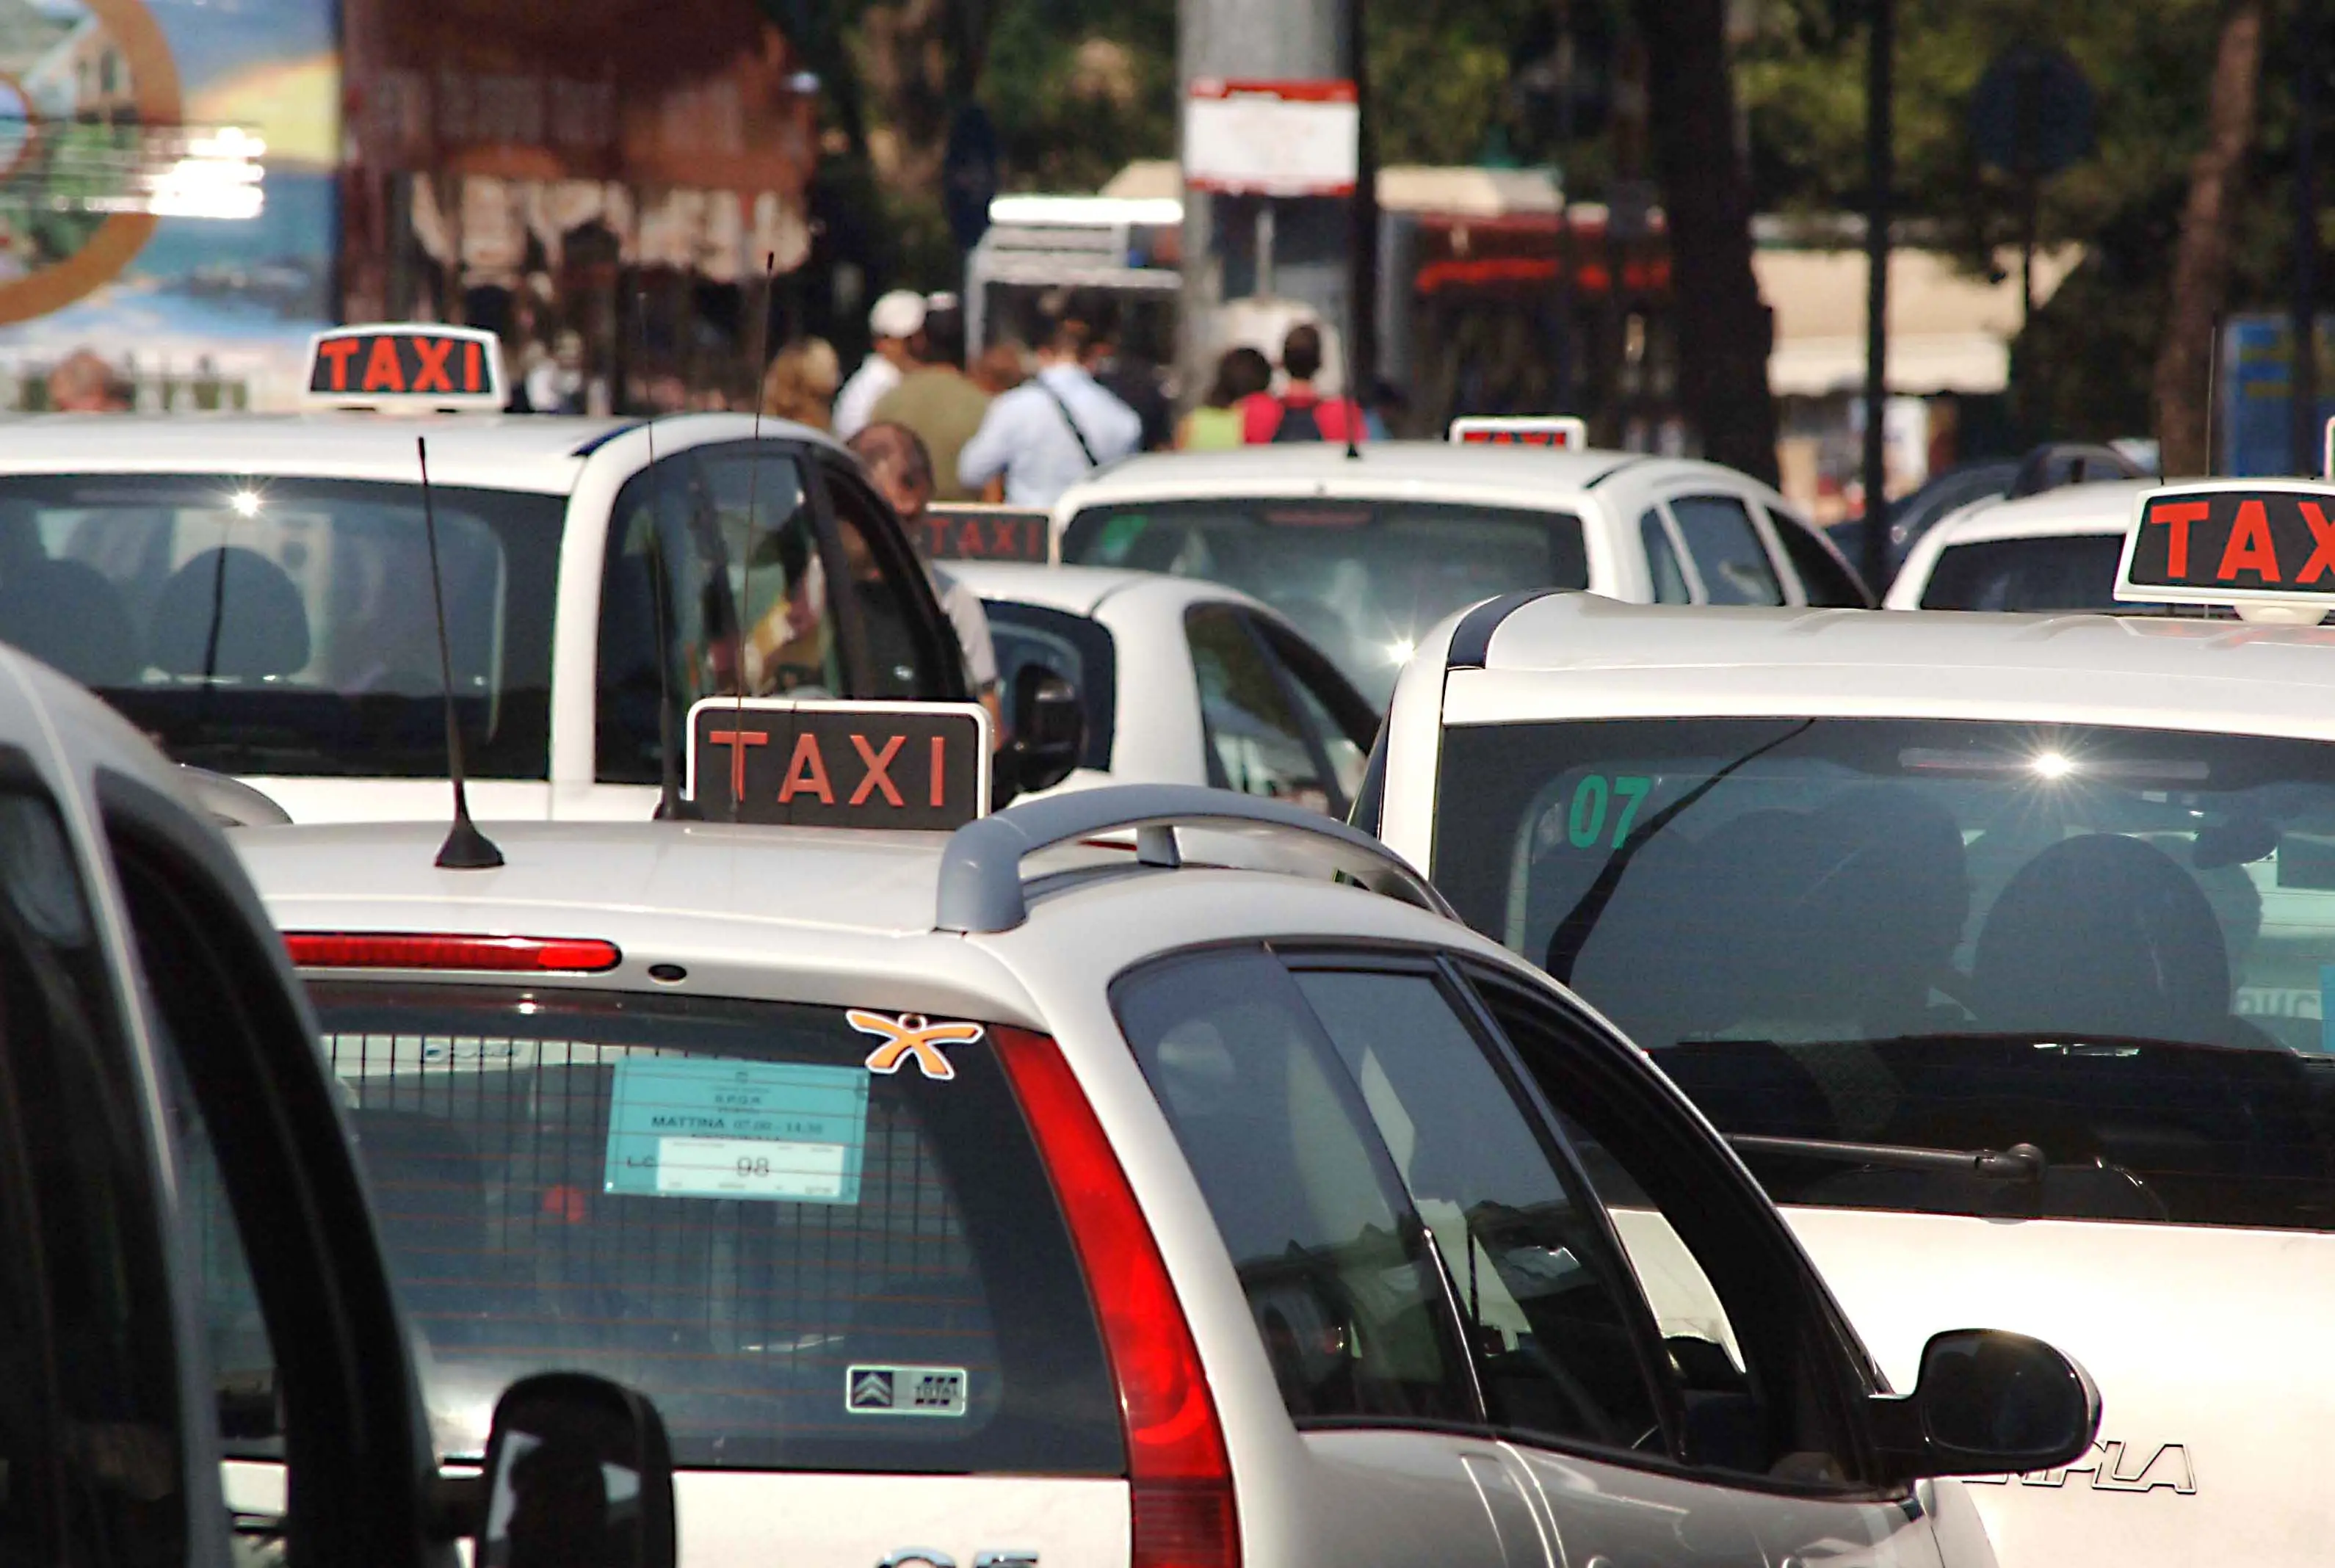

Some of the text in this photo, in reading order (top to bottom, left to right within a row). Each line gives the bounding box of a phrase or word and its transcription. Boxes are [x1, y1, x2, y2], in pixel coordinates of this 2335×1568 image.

[321, 335, 482, 392] TAXI
[928, 518, 1040, 556] TAXI
[709, 730, 945, 807] TAXI
[1569, 774, 1651, 849] 07
[651, 1117, 725, 1130] MATTINA
[736, 1156, 770, 1177] 98
